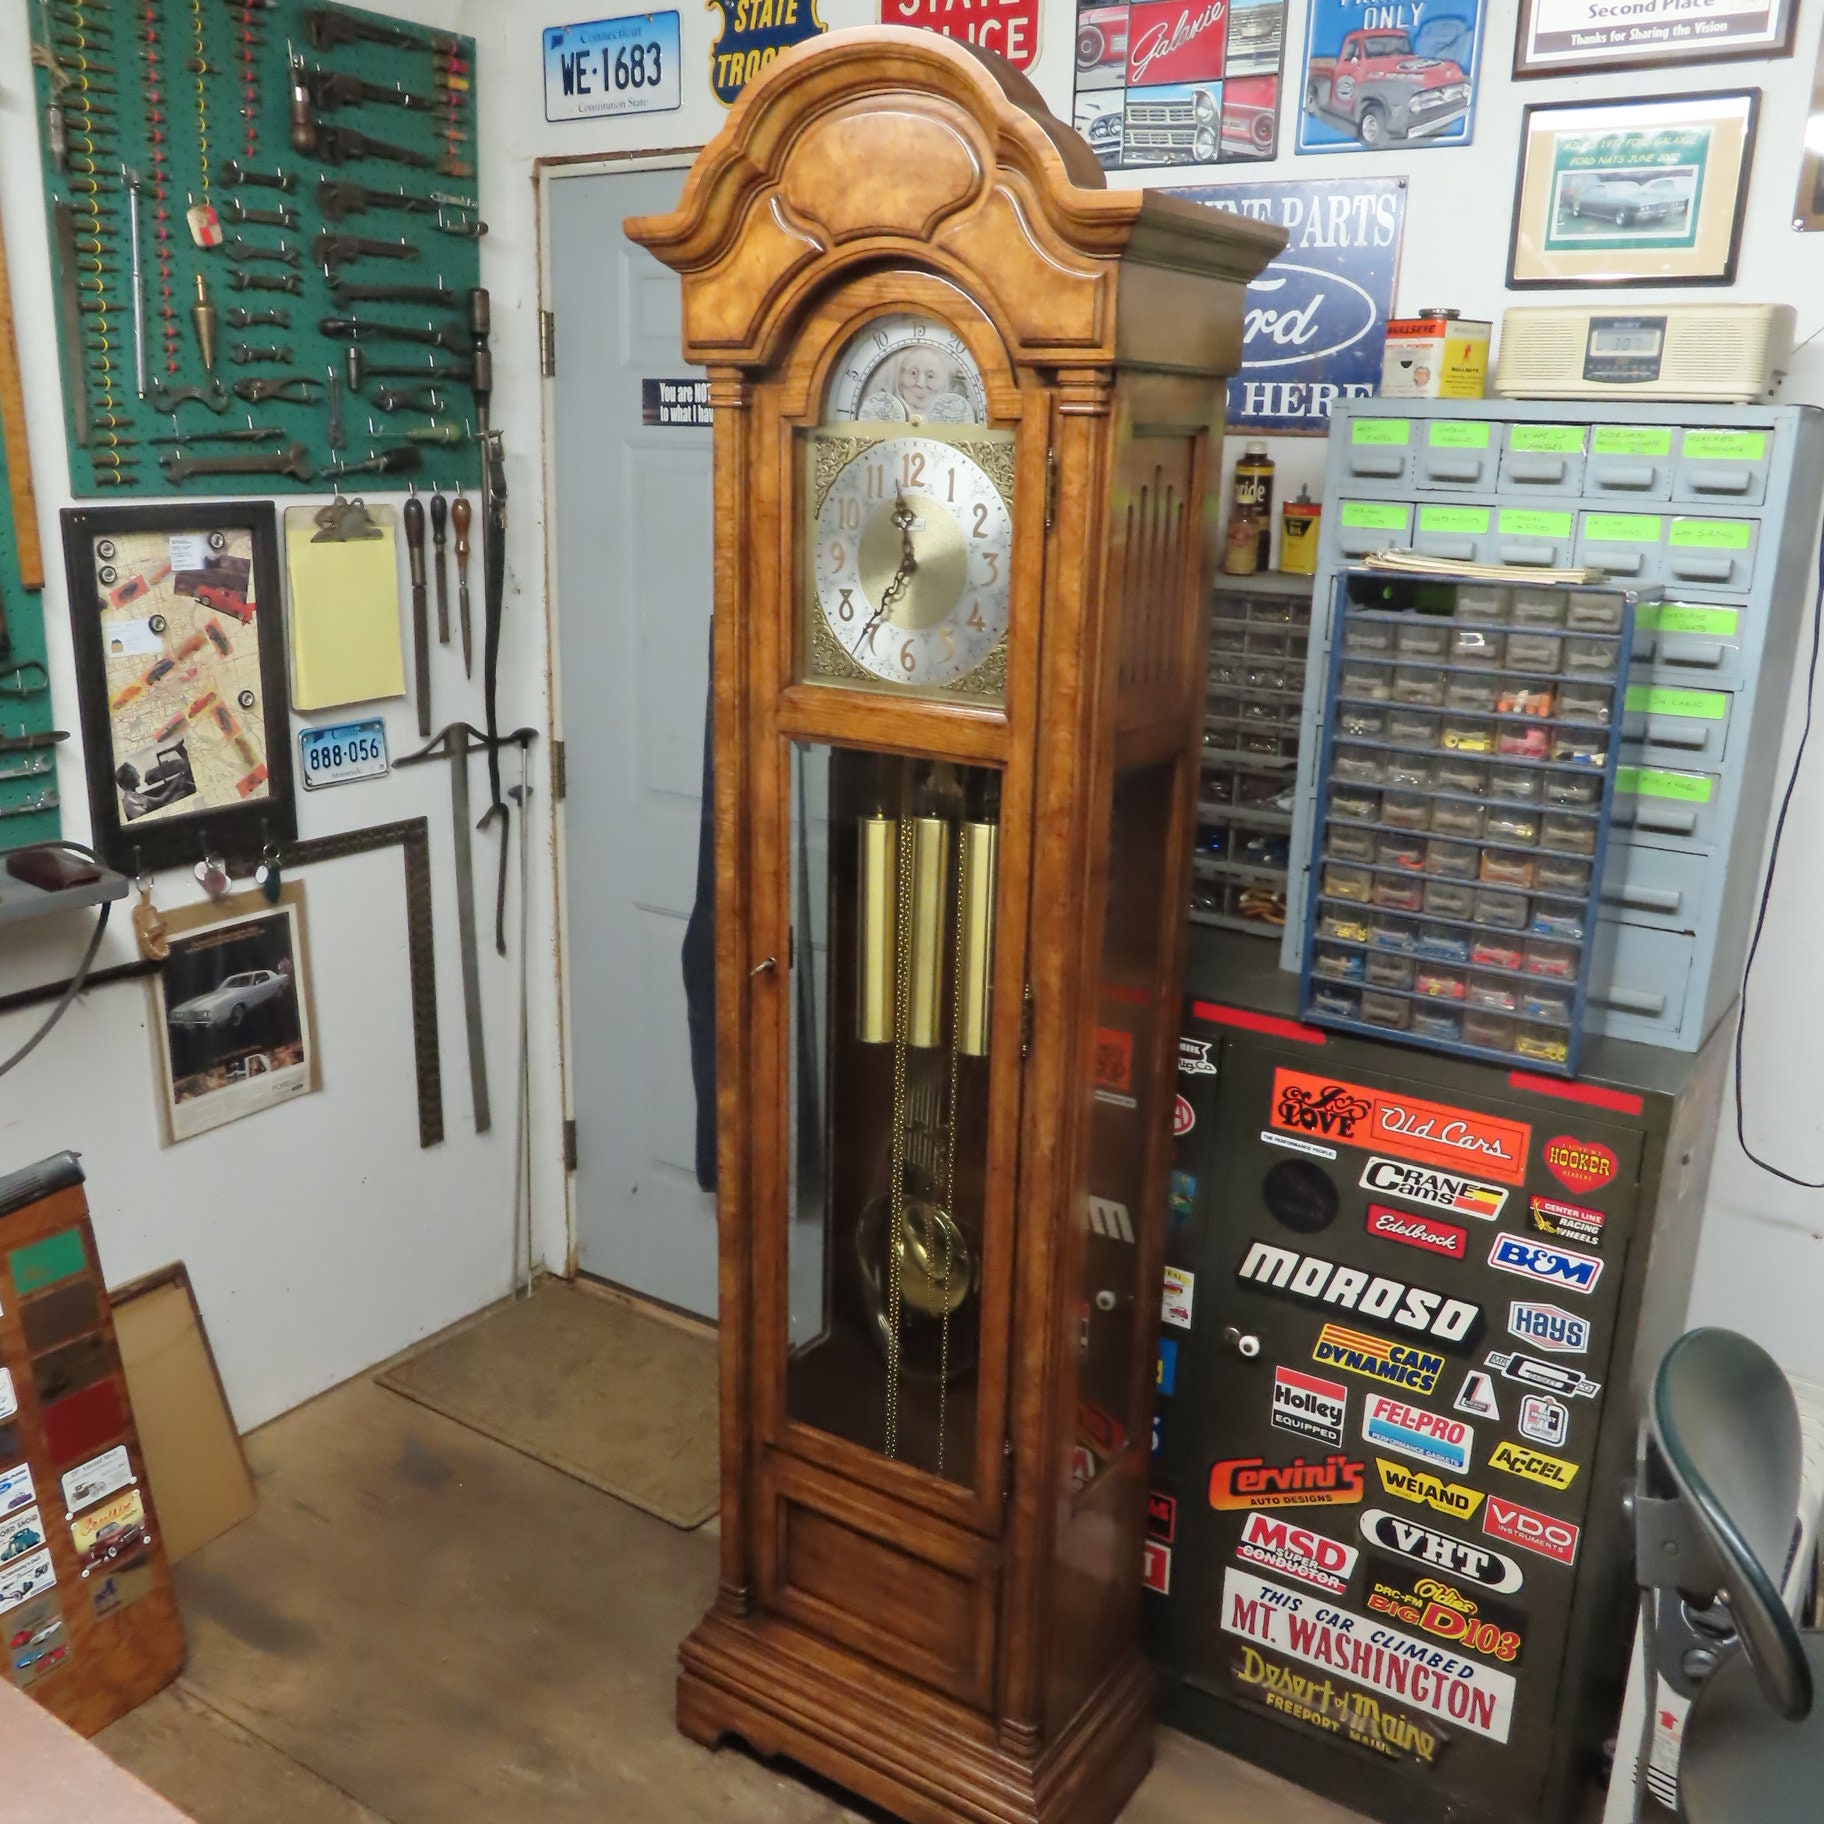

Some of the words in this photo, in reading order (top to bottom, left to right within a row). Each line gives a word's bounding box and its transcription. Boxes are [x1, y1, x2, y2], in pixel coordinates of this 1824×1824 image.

[734, 0, 798, 33] STATE
[1363, 2, 1425, 30] ONLY
[1588, 0, 1656, 19] Second
[580, 25, 643, 43] Connecticut
[1132, 2, 1225, 82] Galaxie
[1571, 31, 1607, 46] Thanks
[1610, 30, 1626, 43] for
[1629, 27, 1669, 42] Sharing
[1672, 23, 1691, 36] the
[1694, 21, 1729, 35] Vision
[1570, 156, 1595, 167] FORD
[1598, 154, 1625, 165] NATS
[1628, 153, 1654, 164] JUNE
[1281, 193, 1397, 249] PARTS
[912, 325, 927, 338] 15
[1386, 324, 1437, 335] BULLSEYE
[660, 382, 677, 402] You
[677, 385, 693, 403] are
[660, 405, 670, 422] to
[670, 404, 692, 422] what
[866, 464, 884, 499] 11
[902, 452, 926, 489] 12
[947, 467, 956, 503] 1
[838, 497, 860, 530] 10
[972, 502, 989, 539] 2
[831, 541, 846, 575] 9
[981, 552, 999, 587] 3
[838, 588, 855, 622] 8
[966, 597, 986, 633] 4
[864, 622, 881, 657] 7
[900, 638, 917, 673] 6
[936, 626, 954, 665] 5
[1282, 1103, 1354, 1138] LOVE
[1380, 1106, 1436, 1140] Old
[1441, 1121, 1512, 1160] Cars
[1274, 1137, 1312, 1151] PERFORMANCE
[1549, 1146, 1611, 1177] HOOKER
[1366, 1161, 1480, 1200] CRANE
[1544, 1202, 1580, 1217] CENTER
[1581, 1212, 1602, 1224] LINE
[1559, 1217, 1600, 1235] RACING
[1375, 1214, 1457, 1250] Edelbrock
[1556, 1226, 1600, 1245] WHEELS
[1497, 1241, 1593, 1285] B&M
[1239, 1242, 1479, 1342] MOROSO
[1516, 1307, 1584, 1347] Hays
[1315, 1342, 1435, 1393] DYNAMICS
[1388, 1345, 1445, 1375] CAM
[1275, 1385, 1343, 1428] Holley
[1372, 1399, 1466, 1445] FEL-PRO
[1275, 1414, 1338, 1441] EQUIPPED
[1371, 1431, 1425, 1455] PERFORMANCE
[1425, 1448, 1461, 1468] GASKETS
[1496, 1447, 1568, 1484] ACCEL
[1208, 1455, 1366, 1511] Cervini's
[1250, 1497, 1280, 1506] AUTO
[1285, 1494, 1333, 1504] DESIGNS
[1385, 1469, 1469, 1510] WEIAND
[1492, 1503, 1572, 1546] VDO
[1497, 1524, 1564, 1553] INSTRUMENTS
[1248, 1516, 1347, 1571] MSD
[1275, 1547, 1319, 1569] SUPER
[1391, 1519, 1490, 1579] VHT
[1242, 1545, 1341, 1589] CONDUCTOR
[1374, 1583, 1424, 1609] DRC-FM
[1413, 1578, 1478, 1615] Oldies
[1260, 1586, 1303, 1612] THIS
[1315, 1608, 1355, 1633] CAR
[1370, 1630, 1475, 1680] CLIMBED
[1367, 1593, 1420, 1625] BIG
[1420, 1601, 1469, 1640] D
[1459, 1618, 1521, 1663] 103
[1231, 1592, 1278, 1644] MT.
[1288, 1613, 1497, 1730] WASHINGTON
[1238, 1645, 1335, 1715] Desert
[1351, 1692, 1435, 1762] Maine
[1265, 1692, 1340, 1733] FREEPORT
